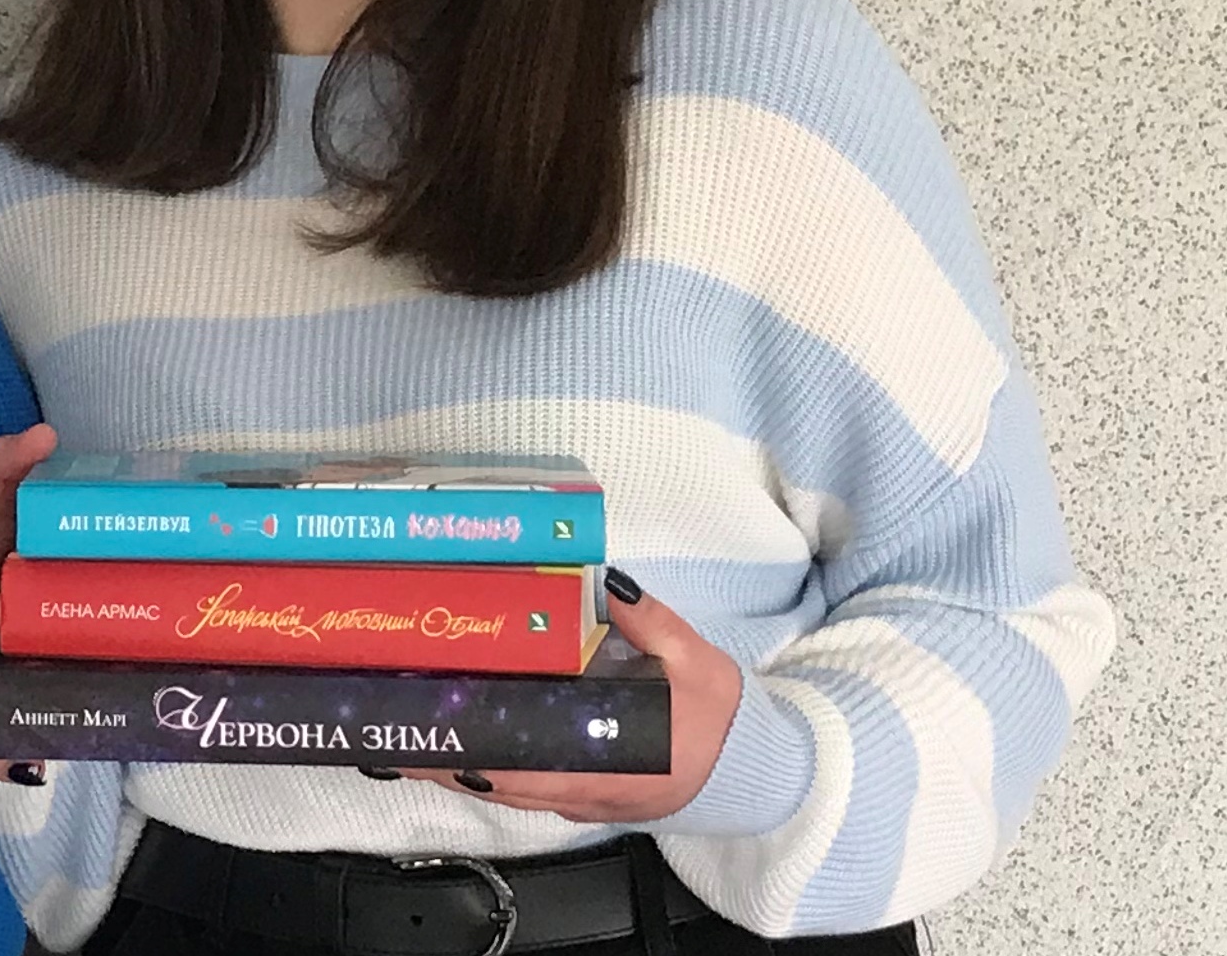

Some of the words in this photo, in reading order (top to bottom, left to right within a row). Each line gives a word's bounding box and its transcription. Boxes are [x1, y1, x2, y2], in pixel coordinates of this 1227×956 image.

[58, 515, 90, 531] АЛІ
[94, 513, 191, 533] ГЕЙЗЕЛВУД
[297, 515, 396, 538] ГІПОТЕЗА
[40, 602, 93, 618] ЕЛЕНА
[96, 604, 161, 621] АРМАС
[152, 685, 350, 748] ЧЕРВОНА
[362, 726, 464, 752] ЗИМА
